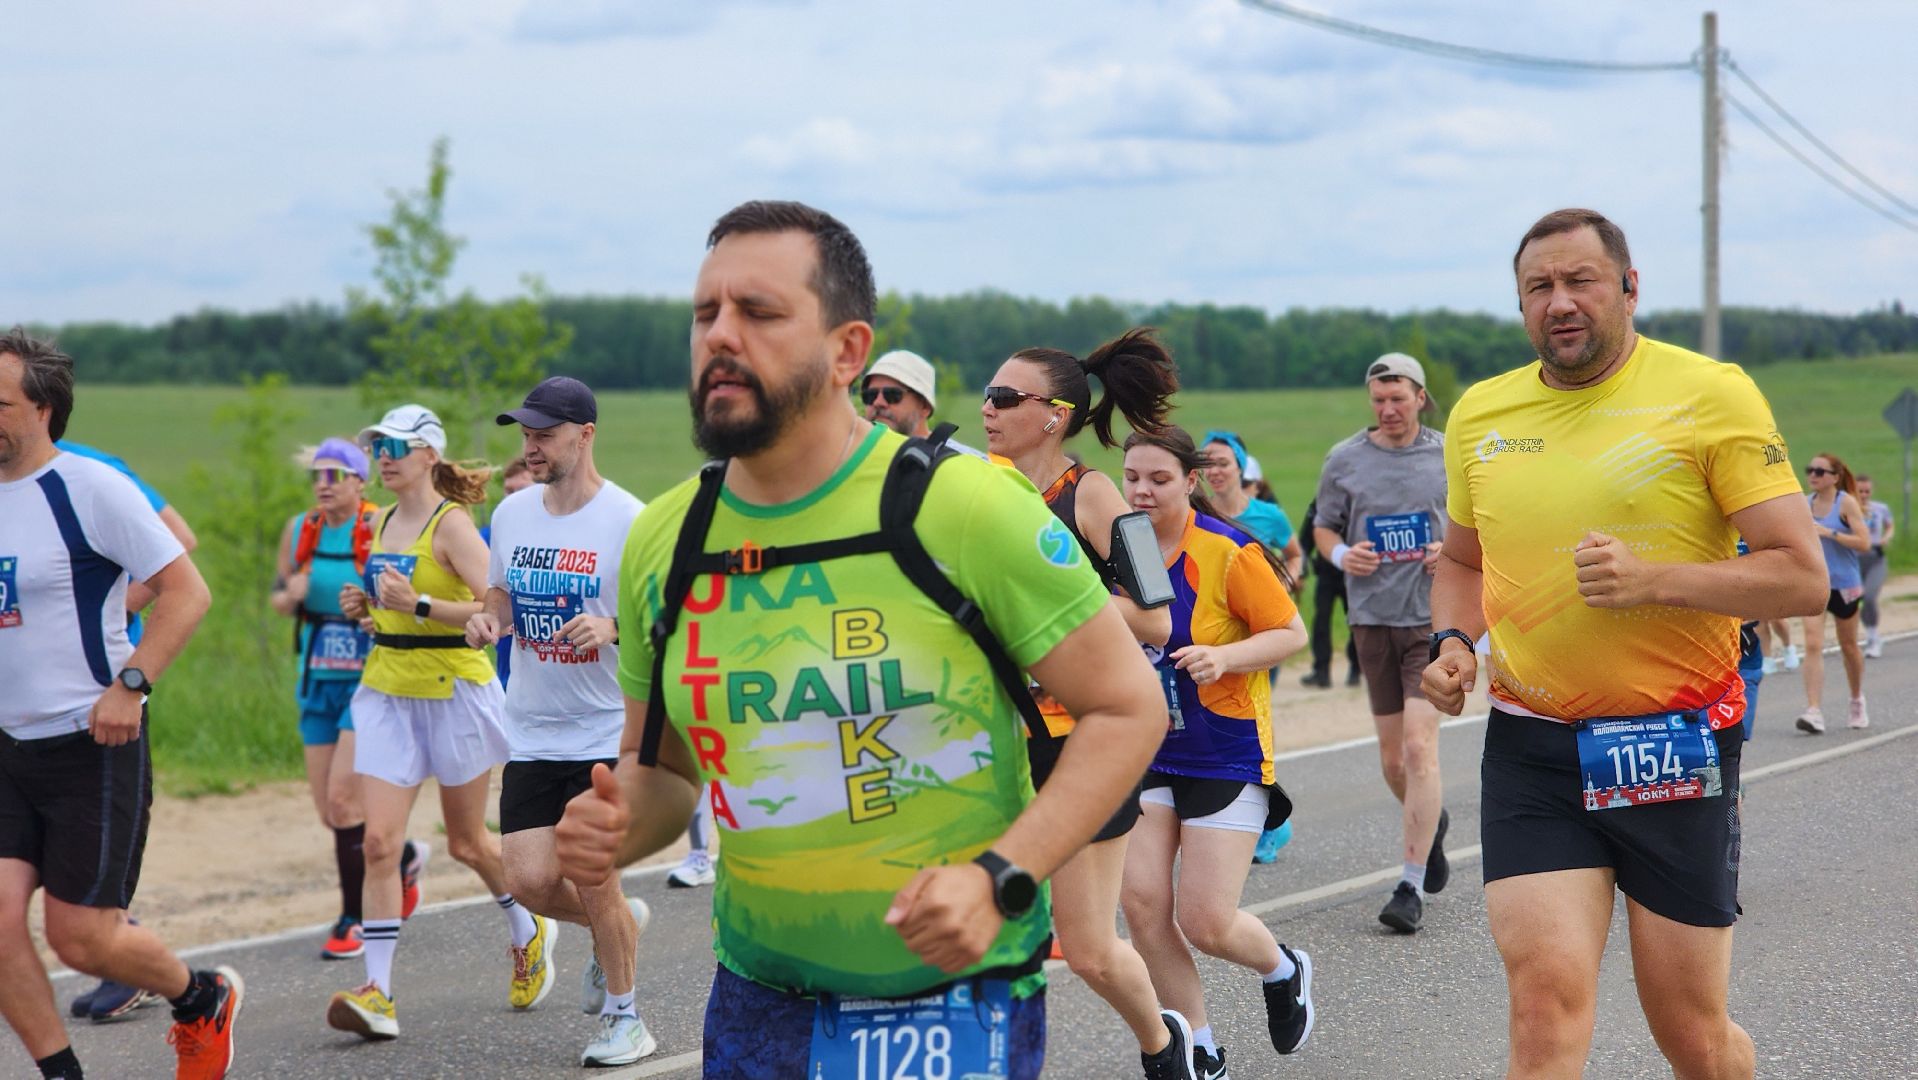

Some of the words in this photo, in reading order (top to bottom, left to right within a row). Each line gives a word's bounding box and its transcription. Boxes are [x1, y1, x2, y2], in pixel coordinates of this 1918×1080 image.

[1519, 445, 1545, 453] RACE
[1380, 529, 1416, 552] 1010
[529, 570, 601, 599] ПЛАНЕТЫ
[680, 659, 935, 725] TRAIL
[832, 607, 902, 825] BIKE
[1606, 741, 1684, 785] 1154
[850, 1025, 952, 1080] 1128
